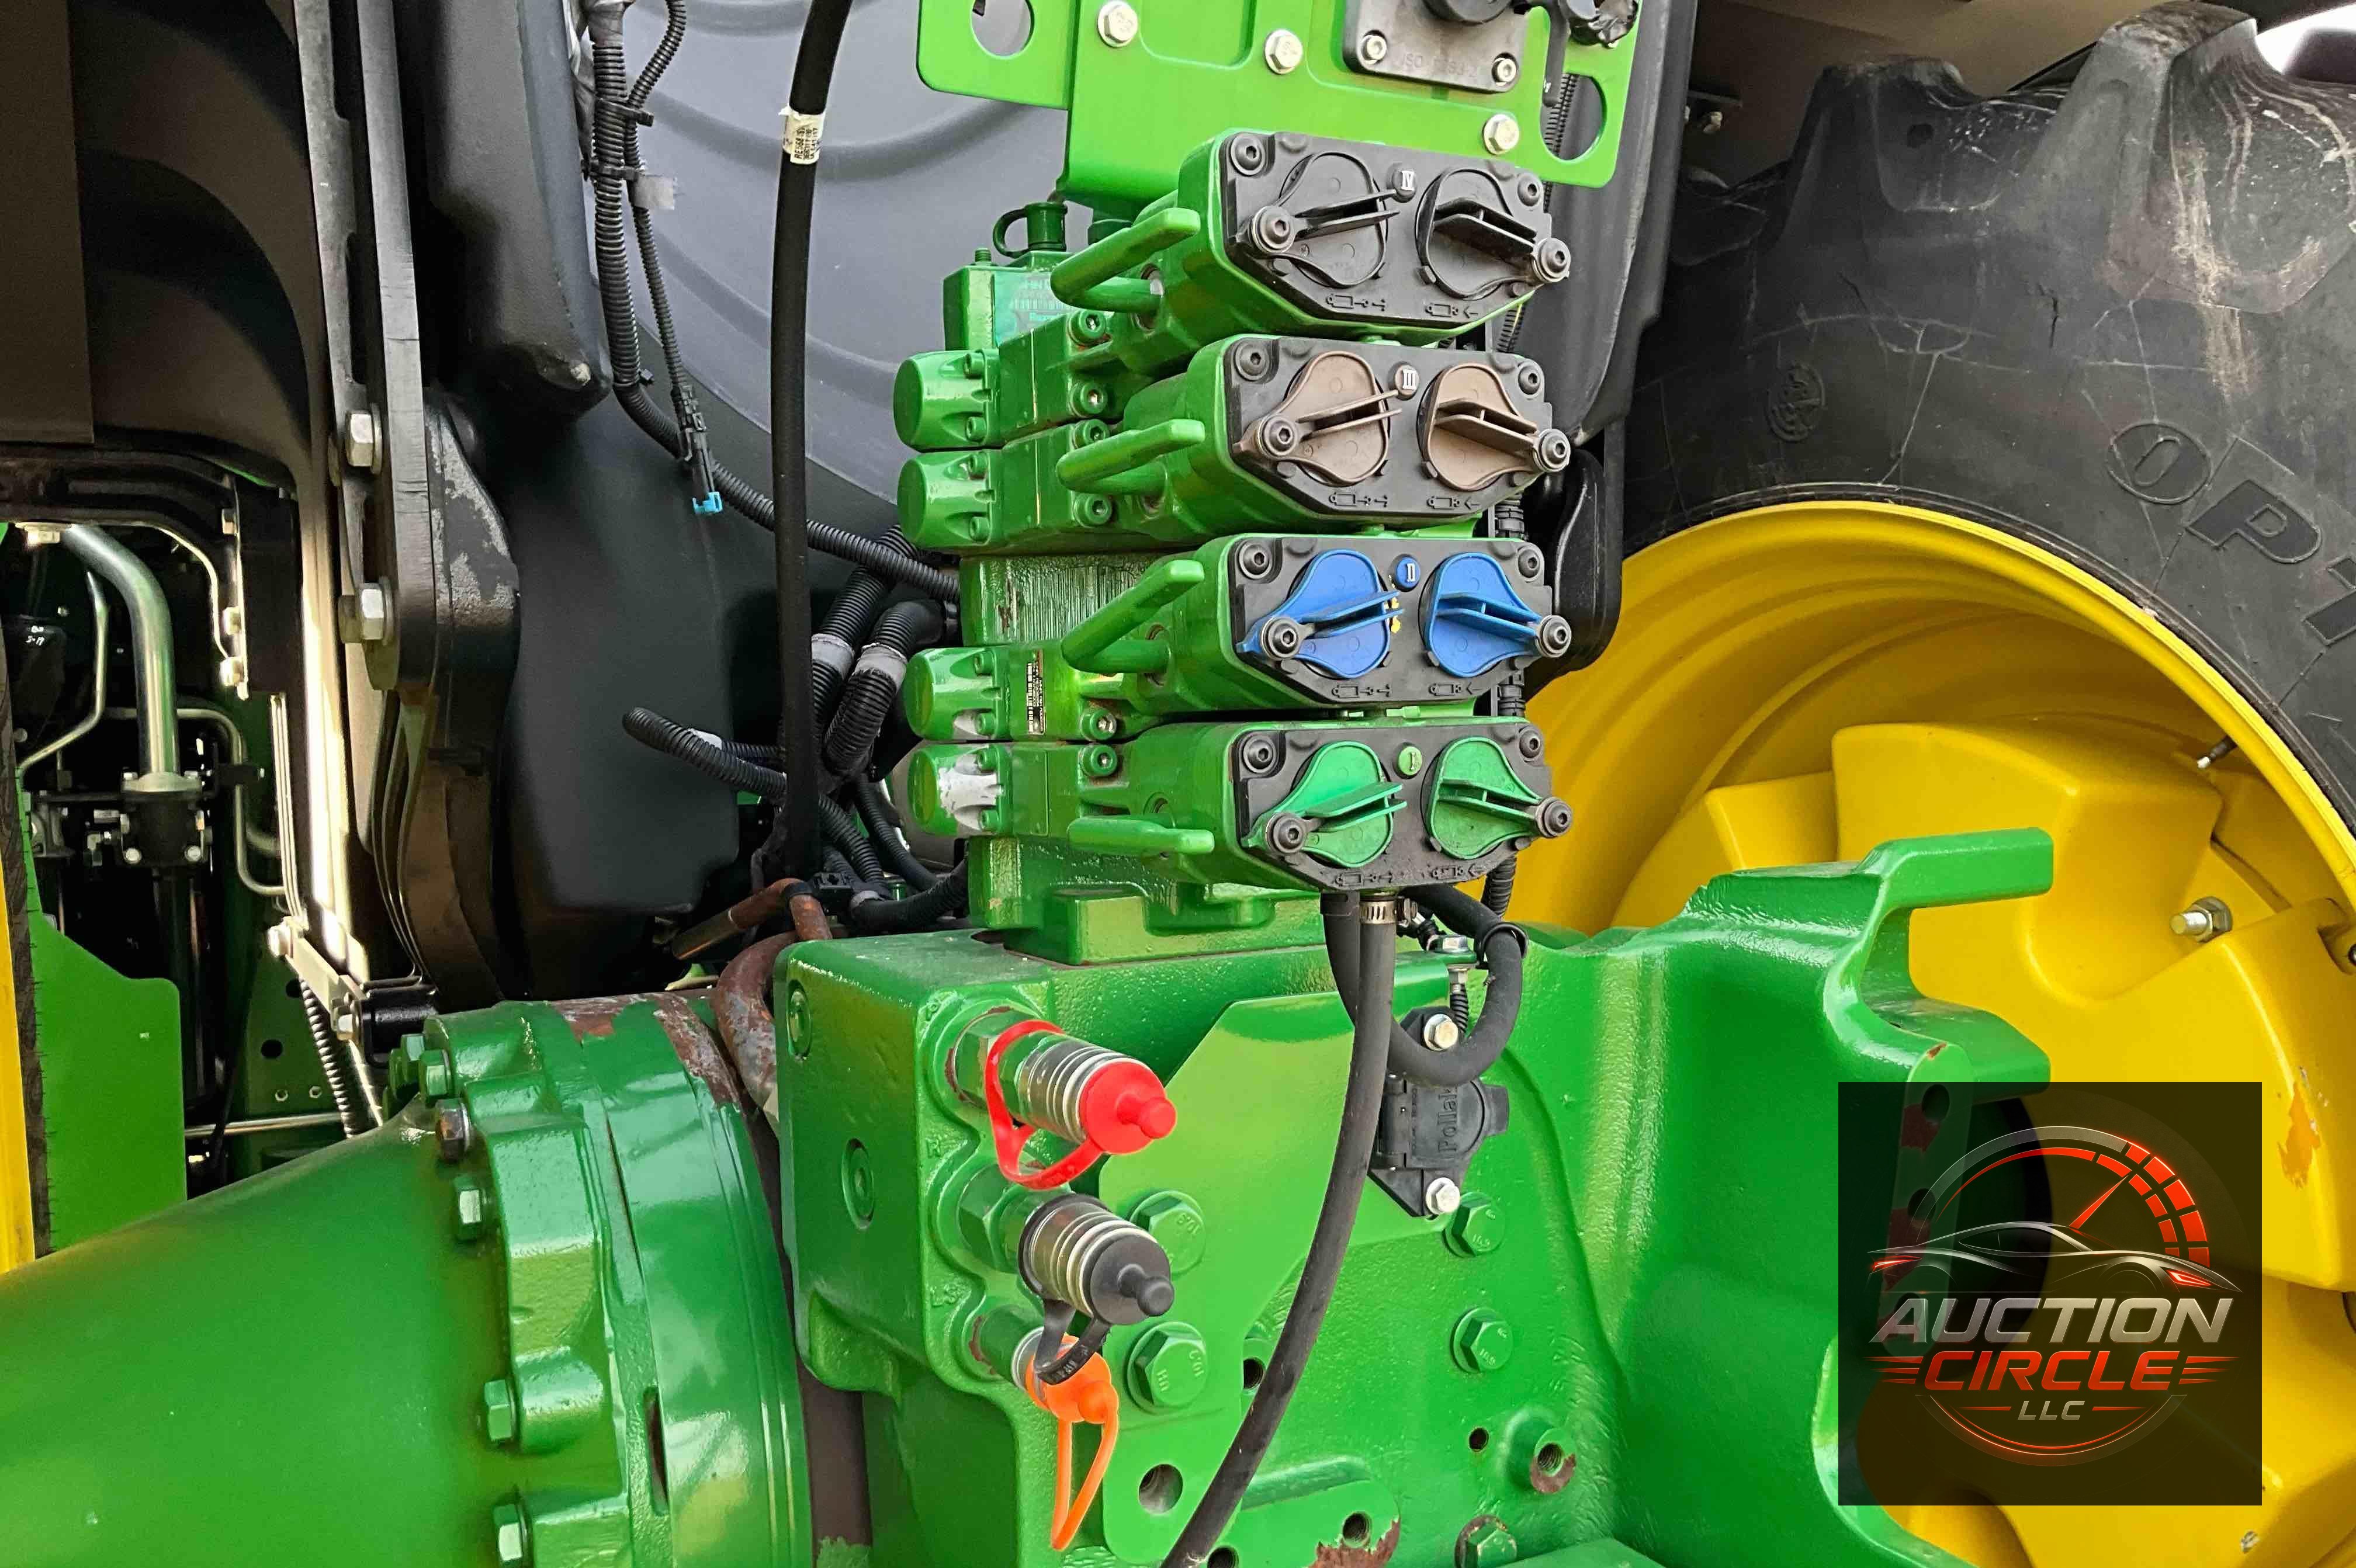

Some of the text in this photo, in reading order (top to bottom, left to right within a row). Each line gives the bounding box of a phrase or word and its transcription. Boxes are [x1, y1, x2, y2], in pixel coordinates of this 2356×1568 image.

[1401, 170, 1415, 191] IV
[1402, 369, 1417, 390] III
[1406, 563, 1416, 582] II
[925, 1137, 940, 1158] R
